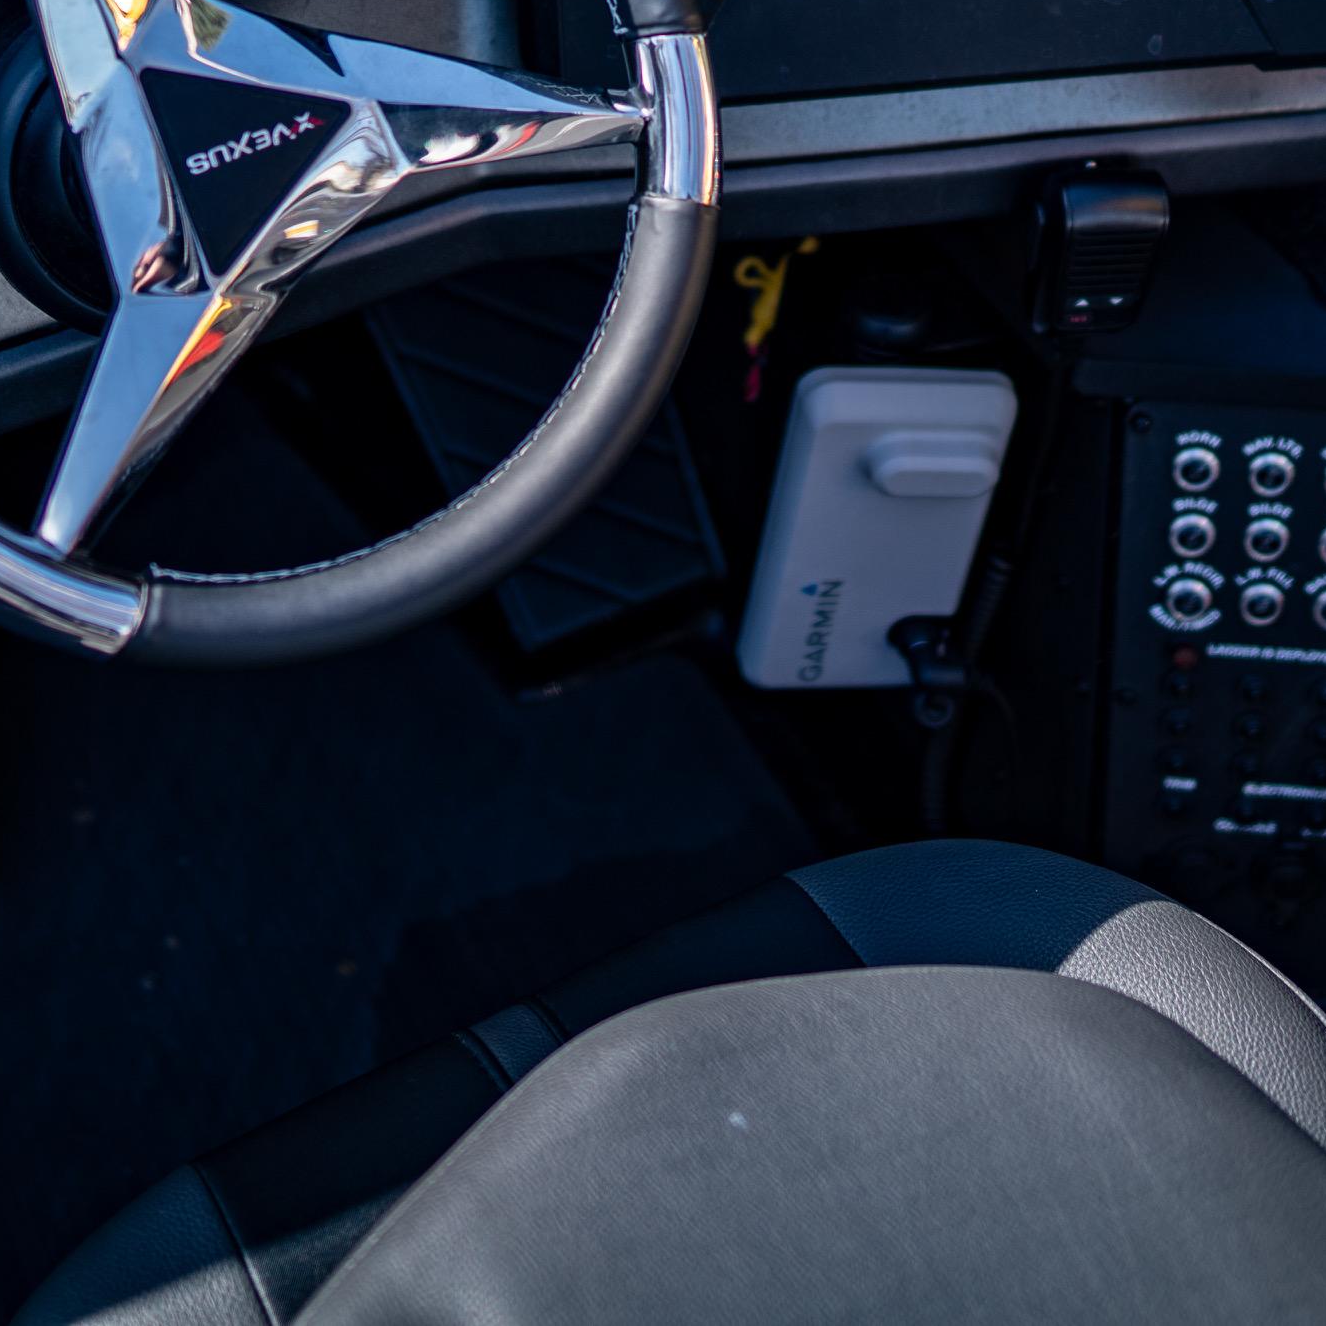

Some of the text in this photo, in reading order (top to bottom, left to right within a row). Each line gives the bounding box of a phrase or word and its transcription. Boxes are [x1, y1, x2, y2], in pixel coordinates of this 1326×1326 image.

[186, 122, 297, 175] VEXUS
[1177, 430, 1222, 448] HORN
[1173, 497, 1219, 514] BILGE
[1247, 503, 1293, 519] BILGE
[798, 580, 844, 682] GARMIN
